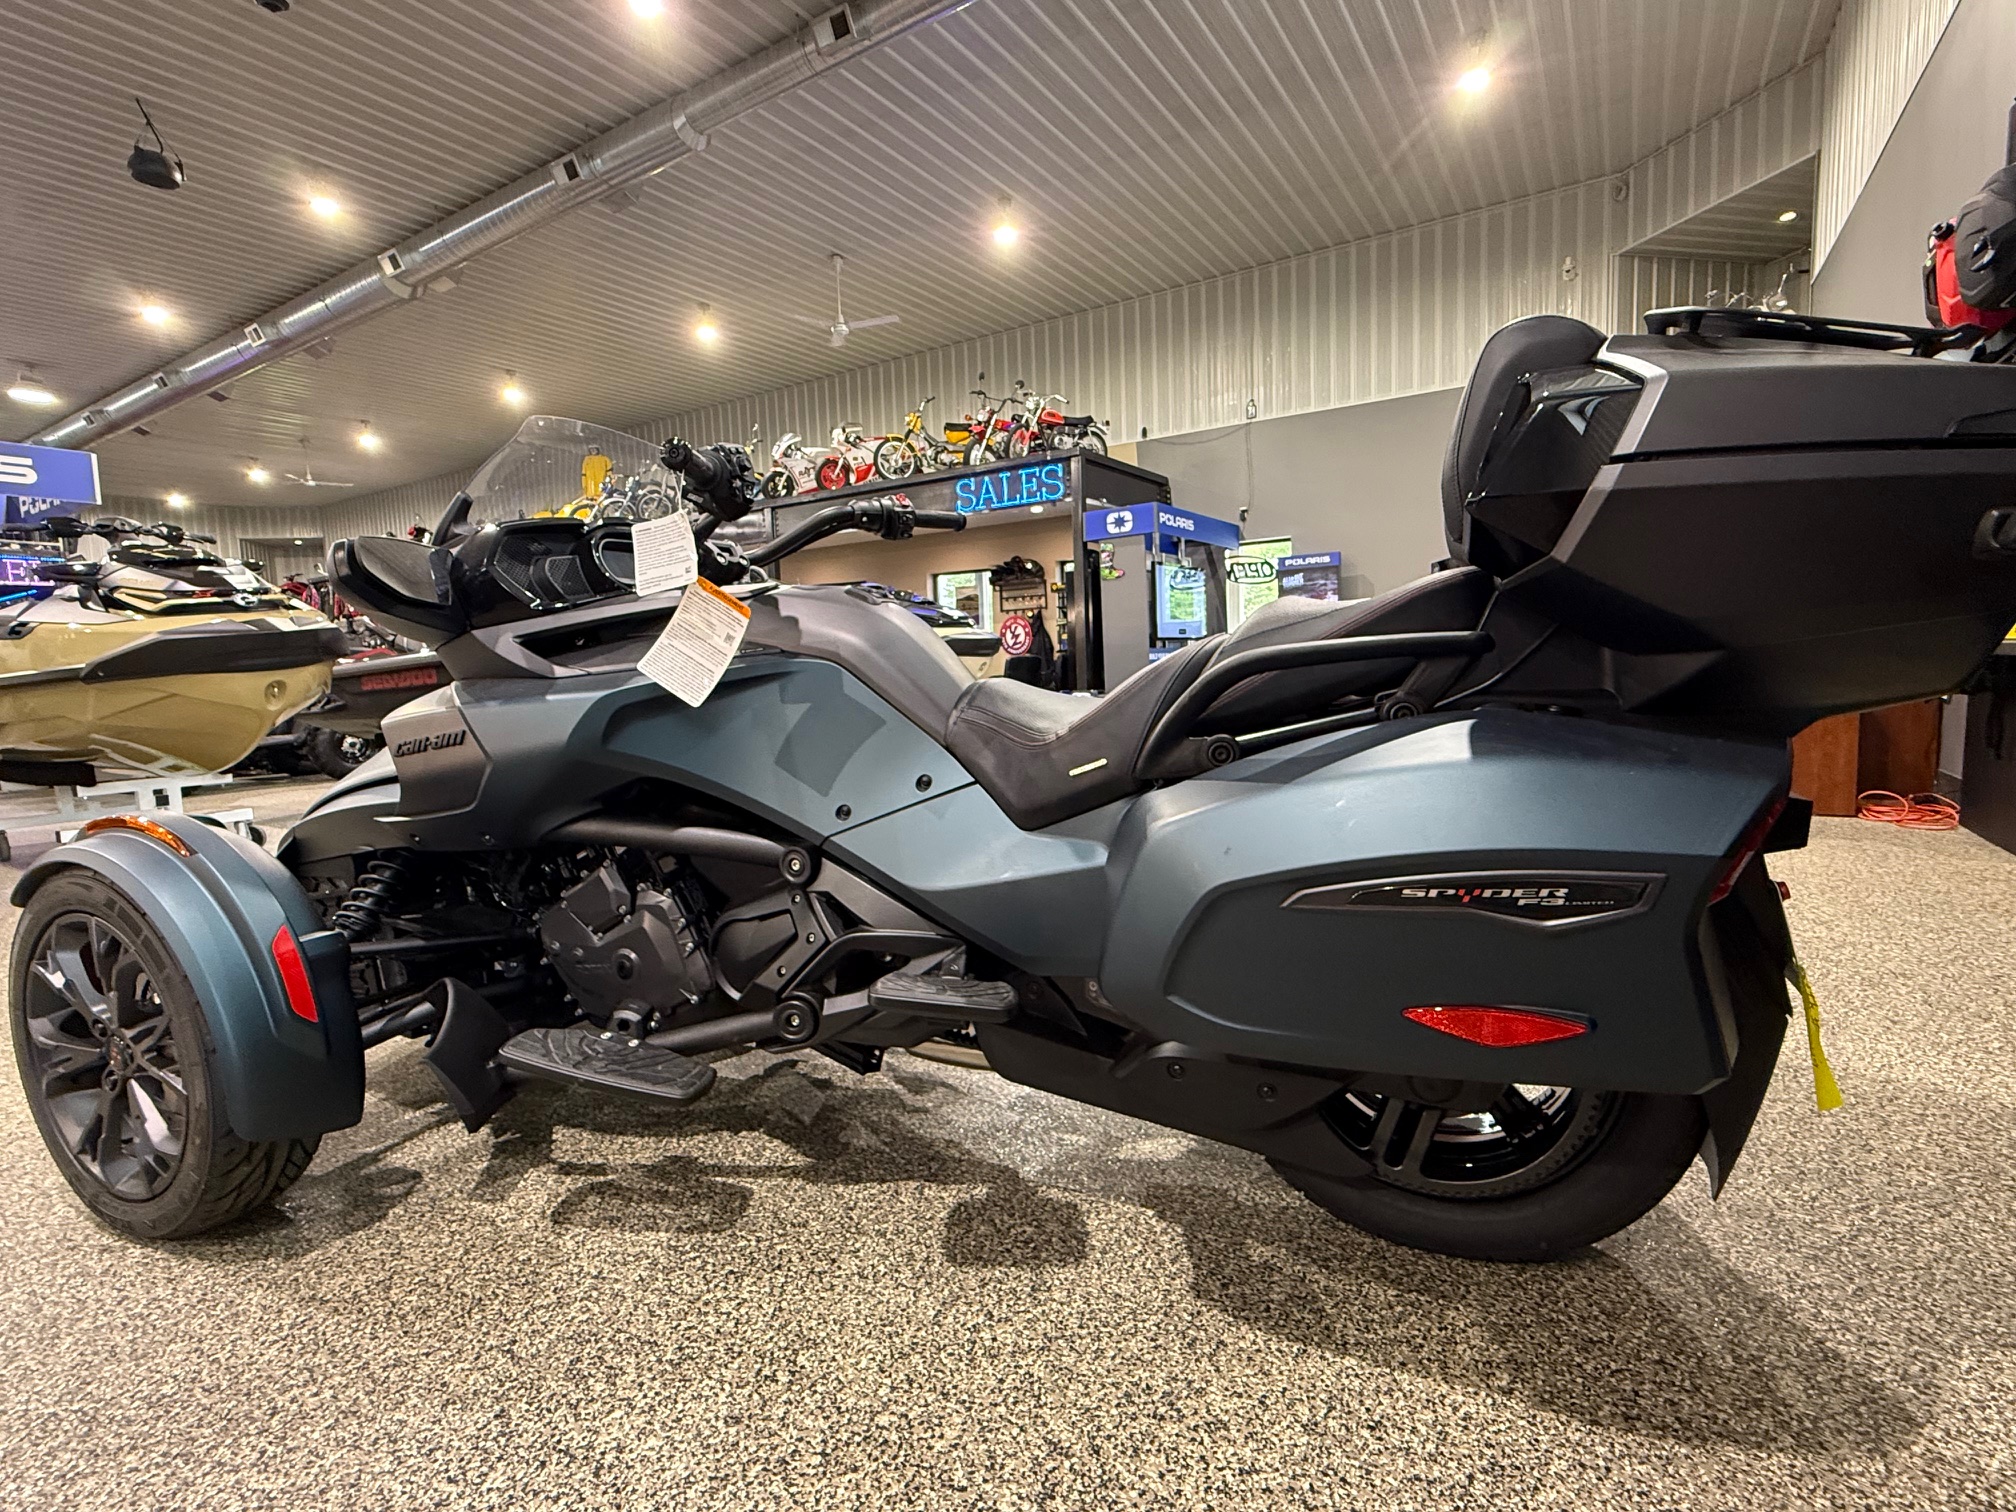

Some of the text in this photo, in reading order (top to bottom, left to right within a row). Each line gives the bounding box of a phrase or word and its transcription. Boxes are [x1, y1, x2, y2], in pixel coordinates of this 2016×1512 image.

[955, 463, 1065, 514] SALES
[1158, 511, 1195, 532] POLARIS
[1284, 555, 1331, 567] POLARIS
[1401, 888, 1570, 903] SPYDER
[1517, 898, 1566, 906] F3
